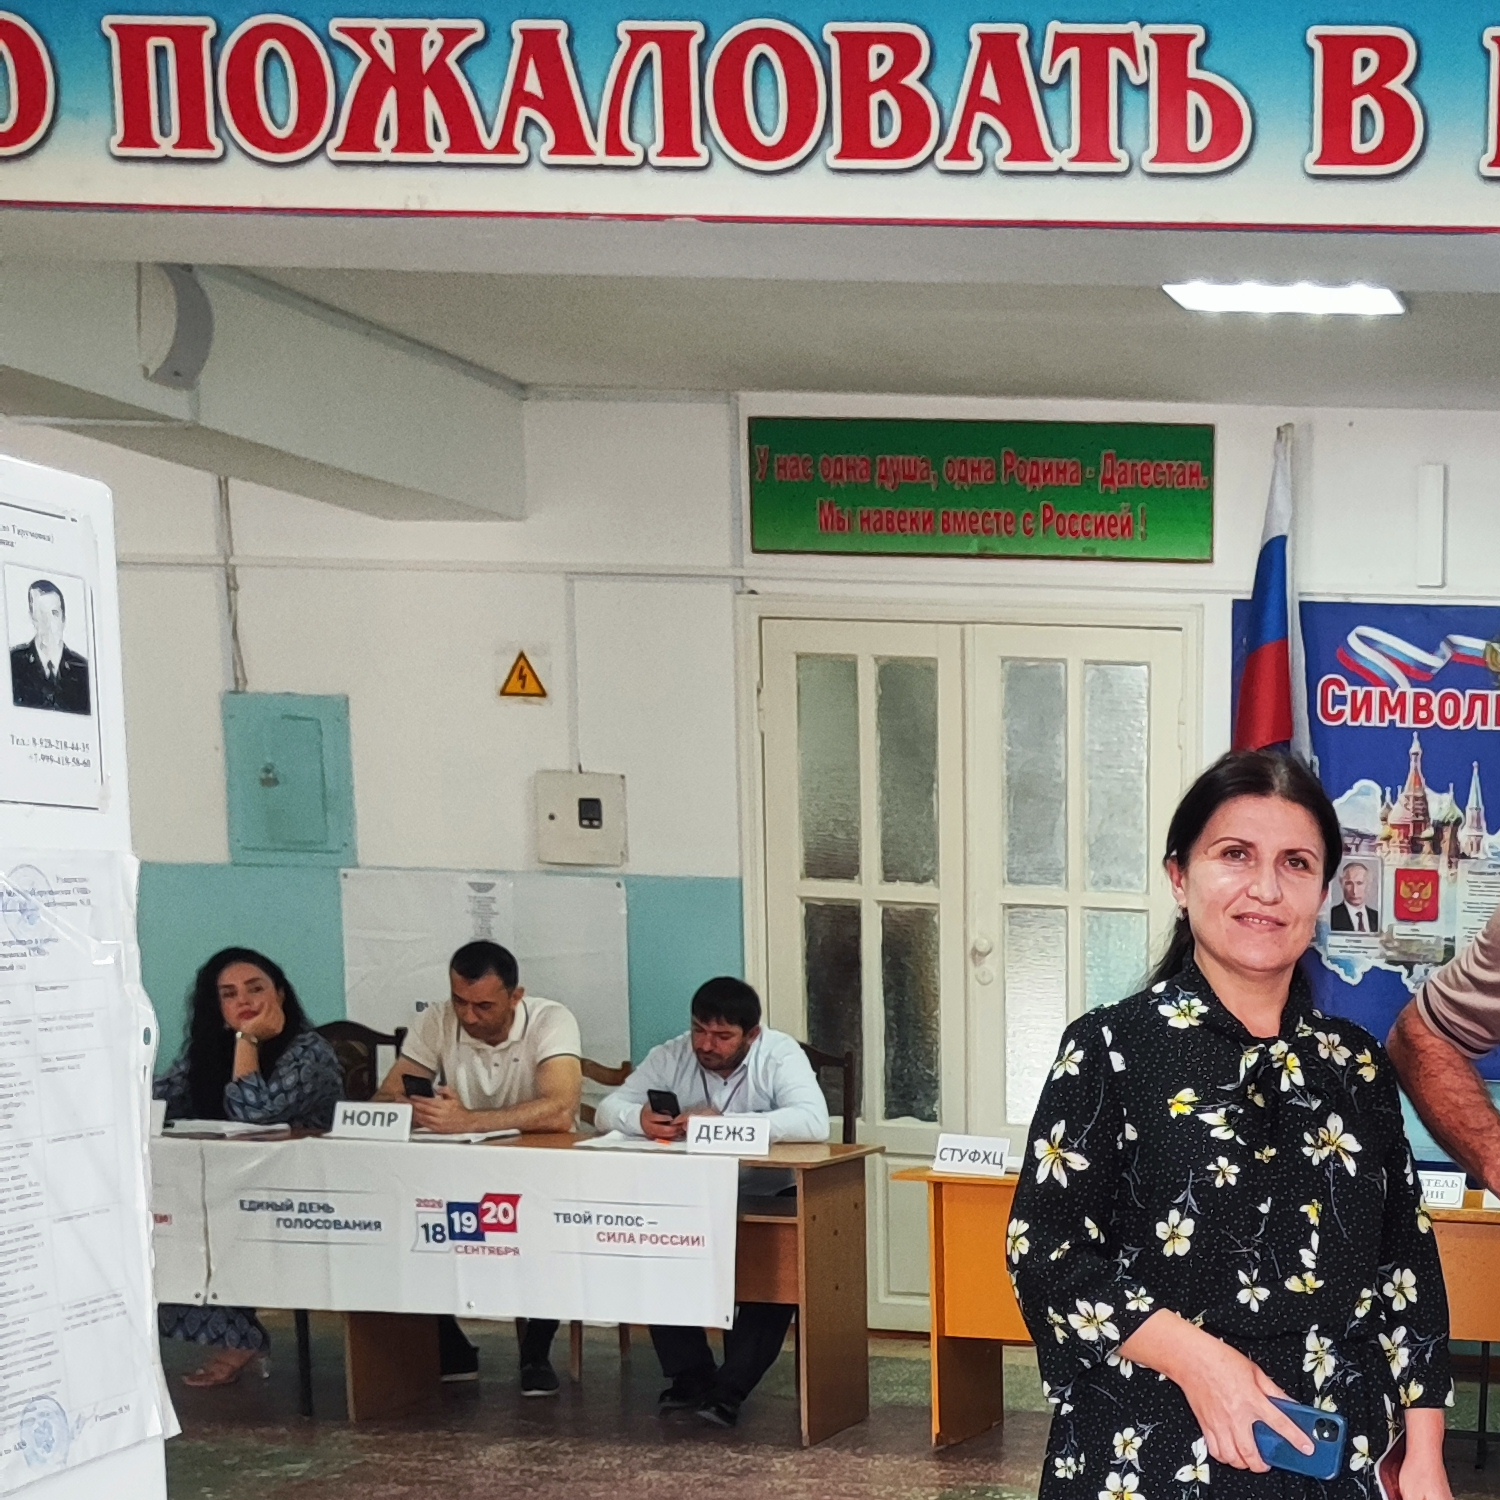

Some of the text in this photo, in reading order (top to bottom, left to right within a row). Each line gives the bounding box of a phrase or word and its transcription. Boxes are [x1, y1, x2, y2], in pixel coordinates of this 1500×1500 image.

[107, 15, 1252, 174] ПОЖАЛОВАТЬ
[1304, 24, 1425, 179] В
[754, 445, 770, 482] У
[774, 453, 814, 482] нас
[819, 454, 872, 486] одна
[876, 454, 939, 491] душа,
[943, 456, 996, 490] одна
[1001, 448, 1082, 492] Родина
[1099, 449, 1209, 494] Дагестан.
[817, 498, 853, 534] Мы
[859, 505, 934, 536] навеки
[941, 509, 1016, 538] вместе
[1022, 512, 1035, 538] с
[1040, 502, 1134, 540] Россией
[342, 1108, 399, 1129] НОПР
[695, 1121, 756, 1145] ДЕЖЗ
[939, 1147, 1005, 1169] СТУФХЦ
[239, 1198, 335, 1214] ЕДИНЫЙ ДЕНЬ
[276, 1217, 382, 1231] ГОЛОСОВАНИЯ
[421, 1201, 515, 1244] 18 19 20
[553, 1211, 592, 1225] ТВОЙ
[596, 1214, 645, 1227] ГОЛОС
[596, 1231, 705, 1247] СИЛА РОССИИ!
[454, 1245, 520, 1256] СЕНТЯБРЯ
